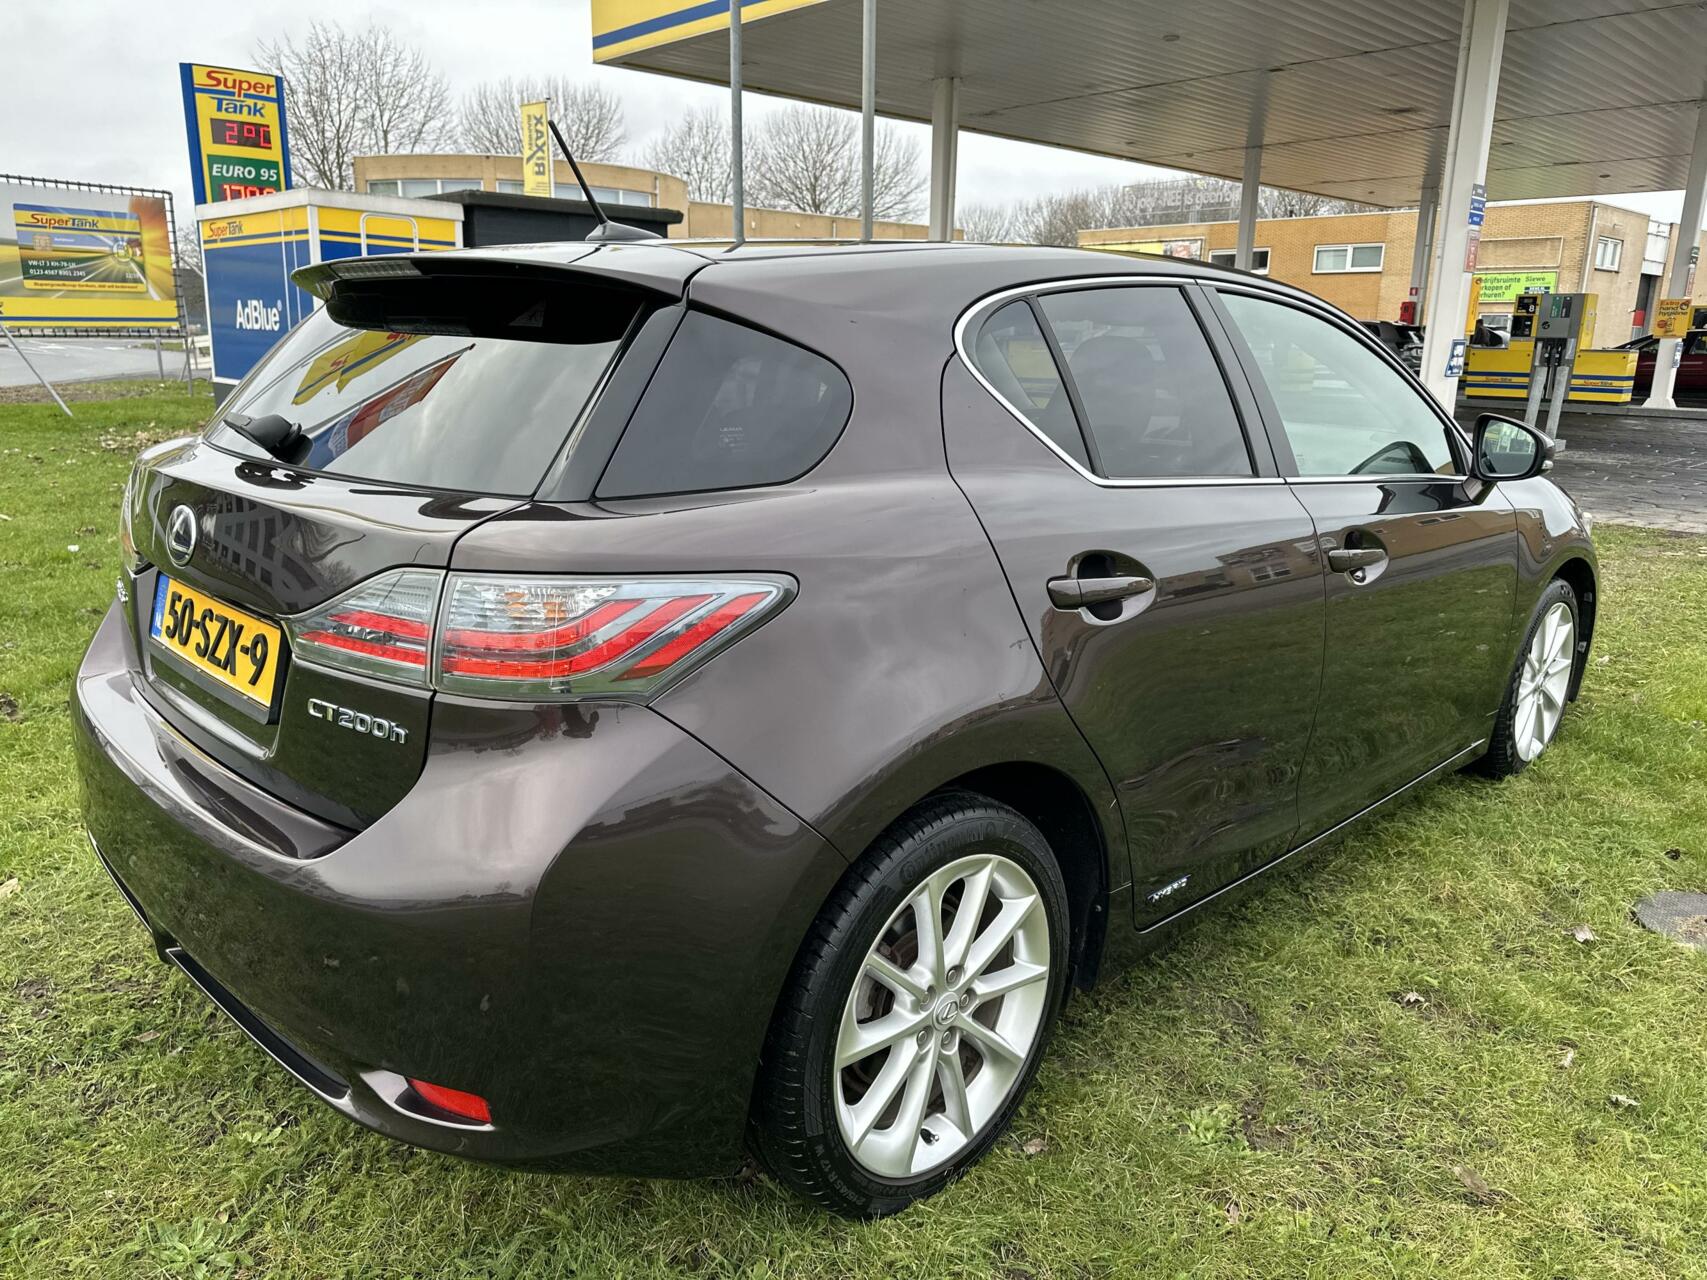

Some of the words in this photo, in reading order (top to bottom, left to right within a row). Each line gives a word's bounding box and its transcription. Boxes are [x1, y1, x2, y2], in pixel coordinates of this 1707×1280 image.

[194, 70, 275, 98] Super
[208, 96, 265, 118] Tank
[212, 164, 256, 179] EURO
[260, 168, 278, 181] 95
[1528, 304, 1535, 313] 8
[165, 590, 270, 686] 50-SZX-9
